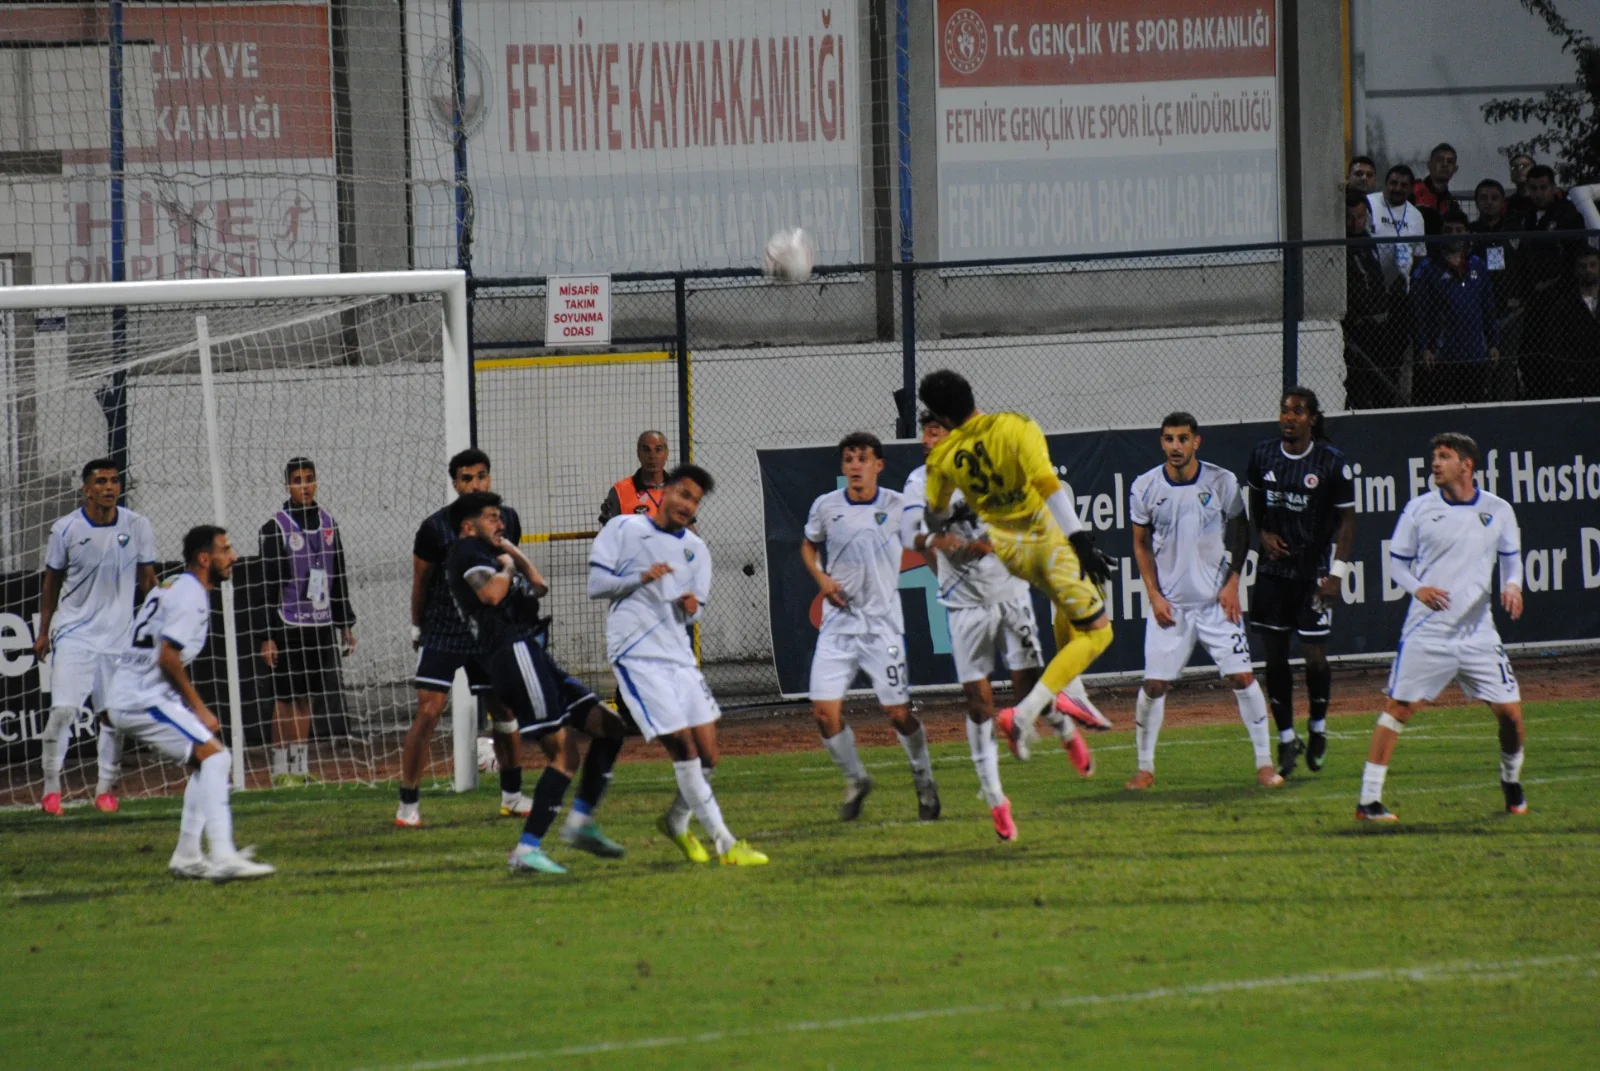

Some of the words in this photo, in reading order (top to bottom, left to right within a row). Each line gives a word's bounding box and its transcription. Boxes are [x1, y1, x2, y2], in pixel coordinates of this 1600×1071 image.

[993, 25, 1024, 57] T.C.
[1029, 16, 1101, 63] GENÇLİK
[1108, 22, 1129, 54] VE
[1136, 20, 1178, 53] SPOR
[1183, 9, 1270, 50] BAKANLIĞI
[217, 42, 259, 79] VE
[506, 16, 622, 152] FETHİYE
[627, 8, 846, 150] KAYMAKAMLIĞI
[946, 101, 1008, 144] FETHİYE
[1011, 99, 1074, 151] GENÇLİK
[1077, 109, 1096, 139] VE
[1099, 107, 1139, 139] SPOR
[1142, 96, 1173, 145] İLÇE
[1176, 90, 1272, 135] MÜDÜRLÜĞÜ
[559, 282, 600, 296] MİSAFİR
[565, 299, 595, 309] TAKIM
[554, 312, 604, 323] SOYUNMA
[563, 326, 594, 337] ODASI
